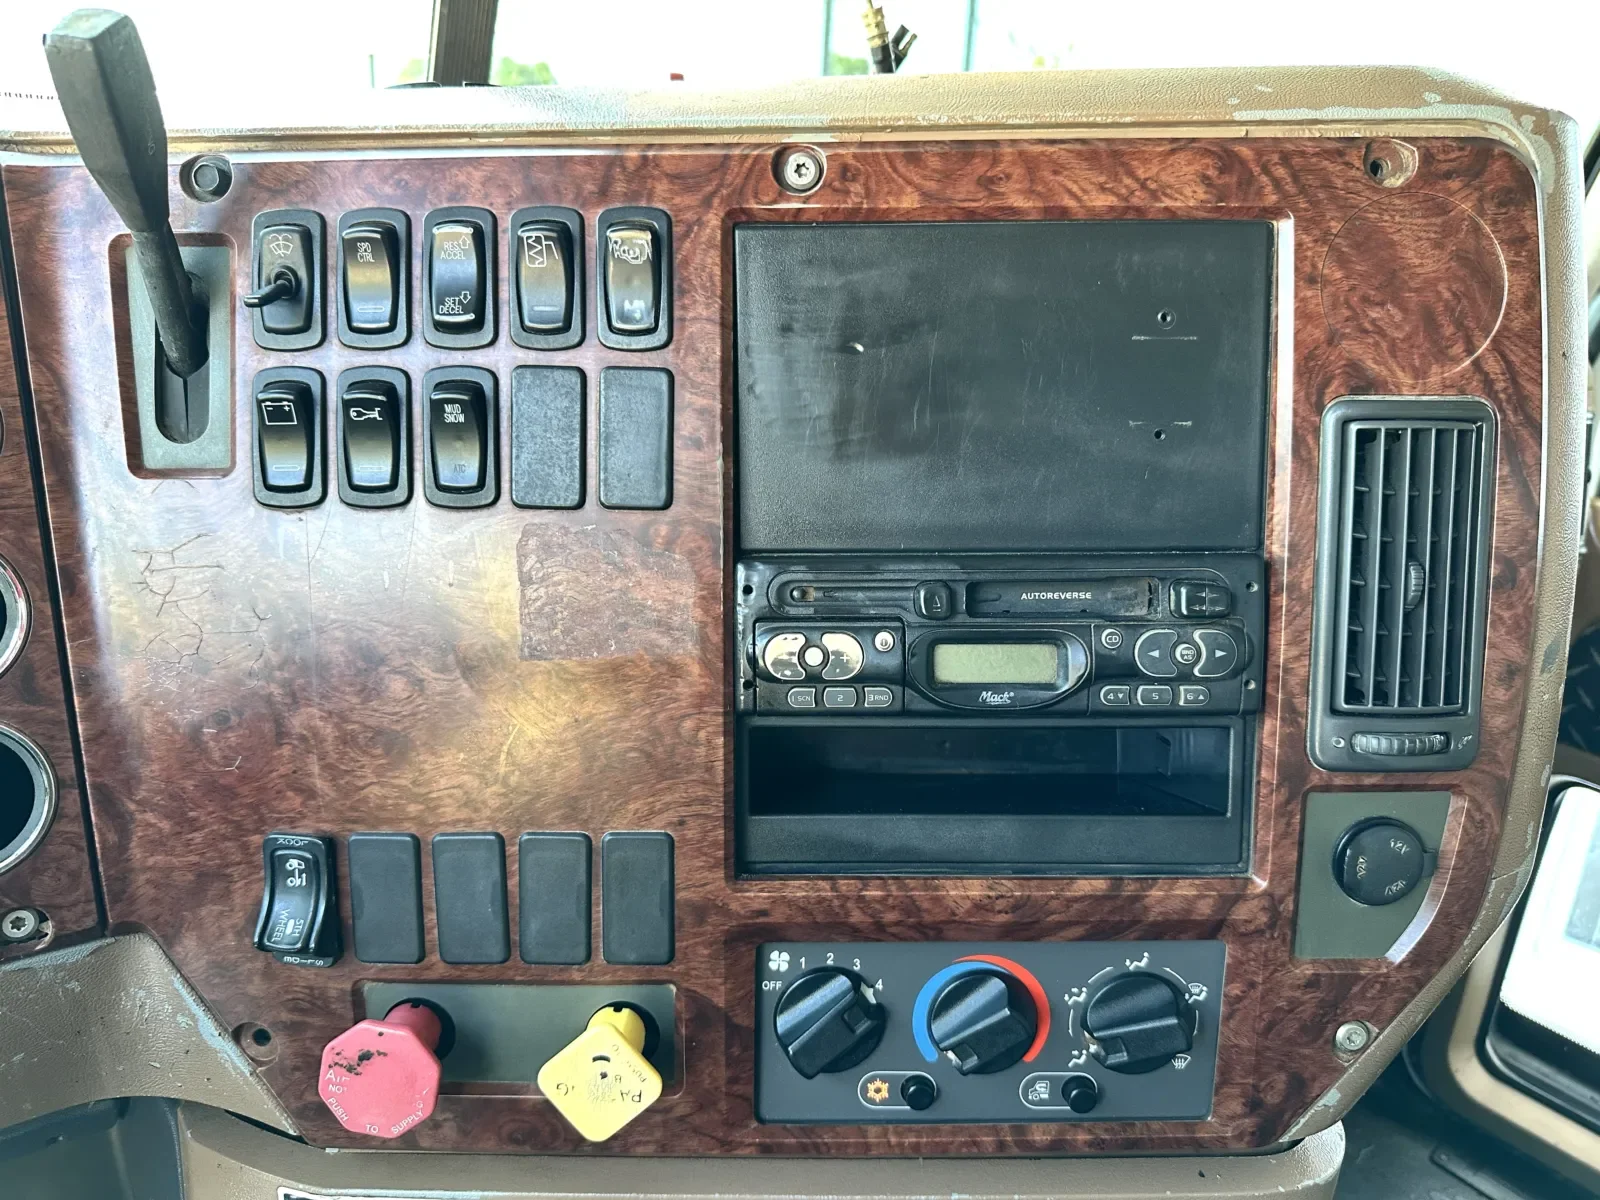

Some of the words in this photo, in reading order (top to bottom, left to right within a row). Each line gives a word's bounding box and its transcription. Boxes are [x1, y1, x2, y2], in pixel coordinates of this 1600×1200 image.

[357, 242, 371, 253] SPD
[357, 252, 375, 262] CTRL
[440, 250, 465, 260] ACCEL
[445, 297, 459, 307] SET
[439, 305, 464, 314] DECEL
[444, 403, 461, 414] MUD
[444, 413, 465, 423] SNOW
[453, 463, 466, 474] ATC
[1020, 591, 1092, 600] AUTOREVERSE
[1106, 635, 1119, 643] CD
[837, 694, 844, 702] 2
[276, 837, 309, 846] LOCK
[271, 908, 291, 943] WHEEL
[292, 917, 304, 937] 5TH
[283, 955, 324, 966] SLIDE
[799, 956, 806, 969] 1
[826, 952, 834, 965] 2
[853, 958, 861, 970] 3
[761, 981, 782, 991] OFF
[875, 978, 883, 991] 4
[328, 1097, 349, 1122] PUSH
[365, 1124, 379, 1133] TO
[391, 1109, 424, 1134] SUPPLY
